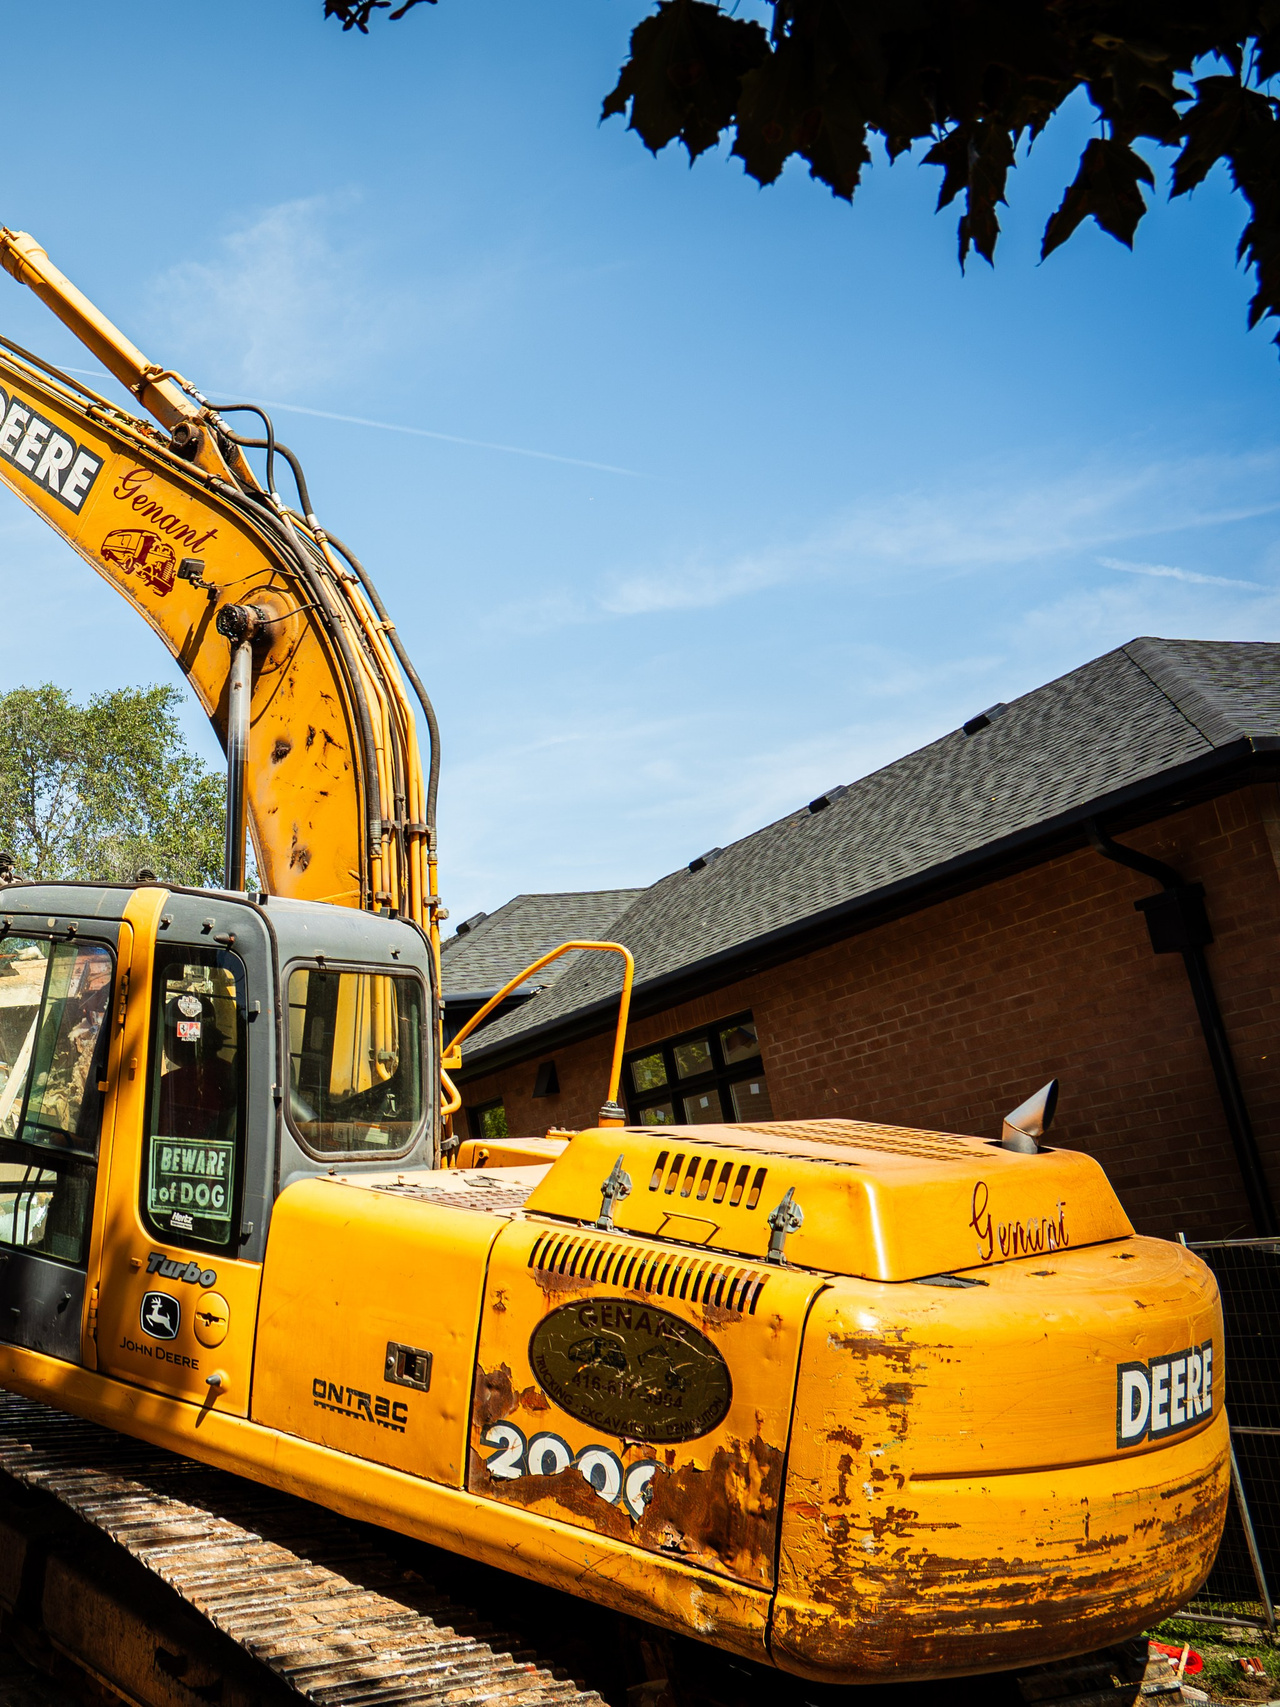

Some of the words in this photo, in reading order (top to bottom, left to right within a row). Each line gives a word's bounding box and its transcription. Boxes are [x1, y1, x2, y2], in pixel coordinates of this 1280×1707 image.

[113, 468, 218, 553] Genant
[160, 1147, 226, 1176] BEWARE
[159, 1181, 177, 1202] of
[180, 1182, 225, 1208] DOG
[171, 1211, 193, 1224] Hertz
[146, 1252, 217, 1288] Turbo
[578, 1305, 690, 1348] GENANT
[120, 1337, 152, 1357] JOHN
[155, 1347, 200, 1370] DEERE
[535, 1354, 573, 1406] TRUCKING
[1120, 1345, 1212, 1440] DEERE
